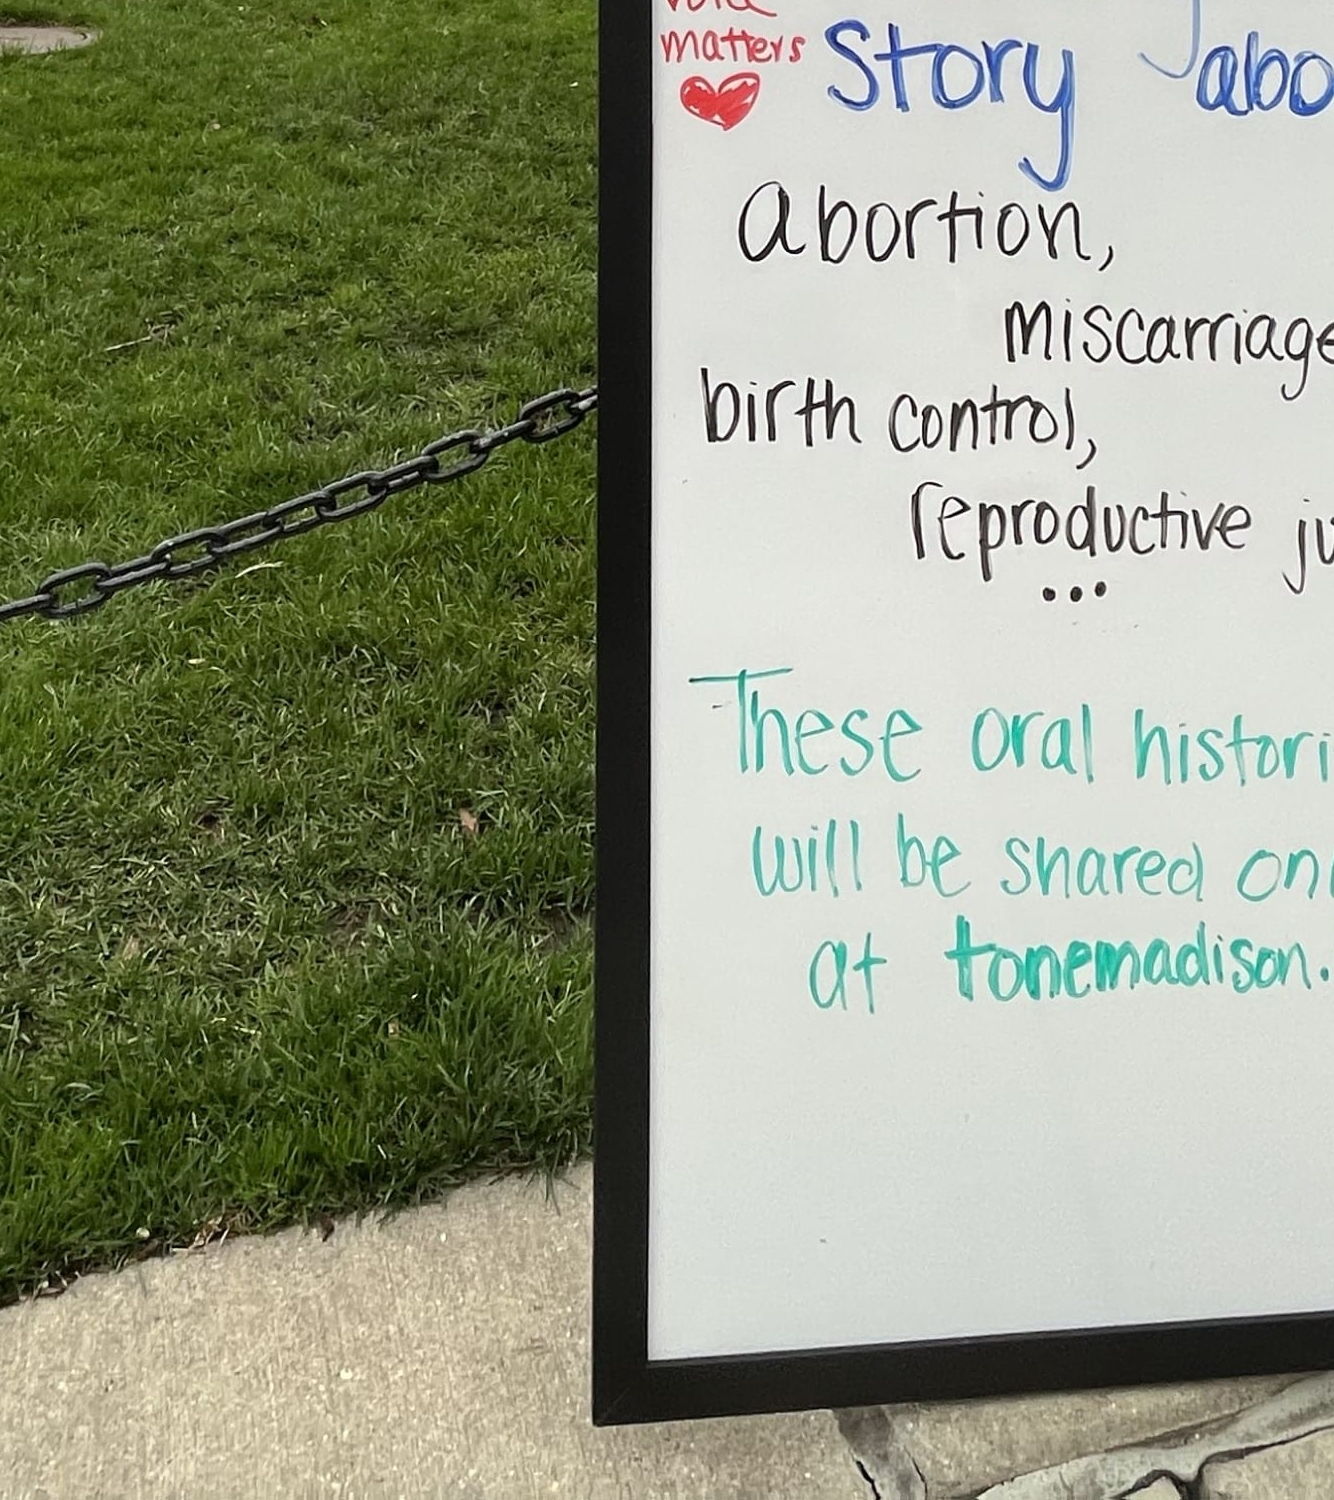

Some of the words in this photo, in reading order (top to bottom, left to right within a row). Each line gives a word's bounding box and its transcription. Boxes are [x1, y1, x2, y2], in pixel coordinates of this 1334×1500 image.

[660, 26, 807, 64] matters
[701, 367, 863, 448] birth
[888, 384, 1097, 471] control,
[911, 481, 1252, 583] reproductive
[688, 667, 924, 782] These
[972, 703, 1095, 785] oral
[752, 818, 863, 898] will
[897, 811, 972, 898] be
[1000, 836, 1204, 903] shared
[809, 932, 887, 1015] at
